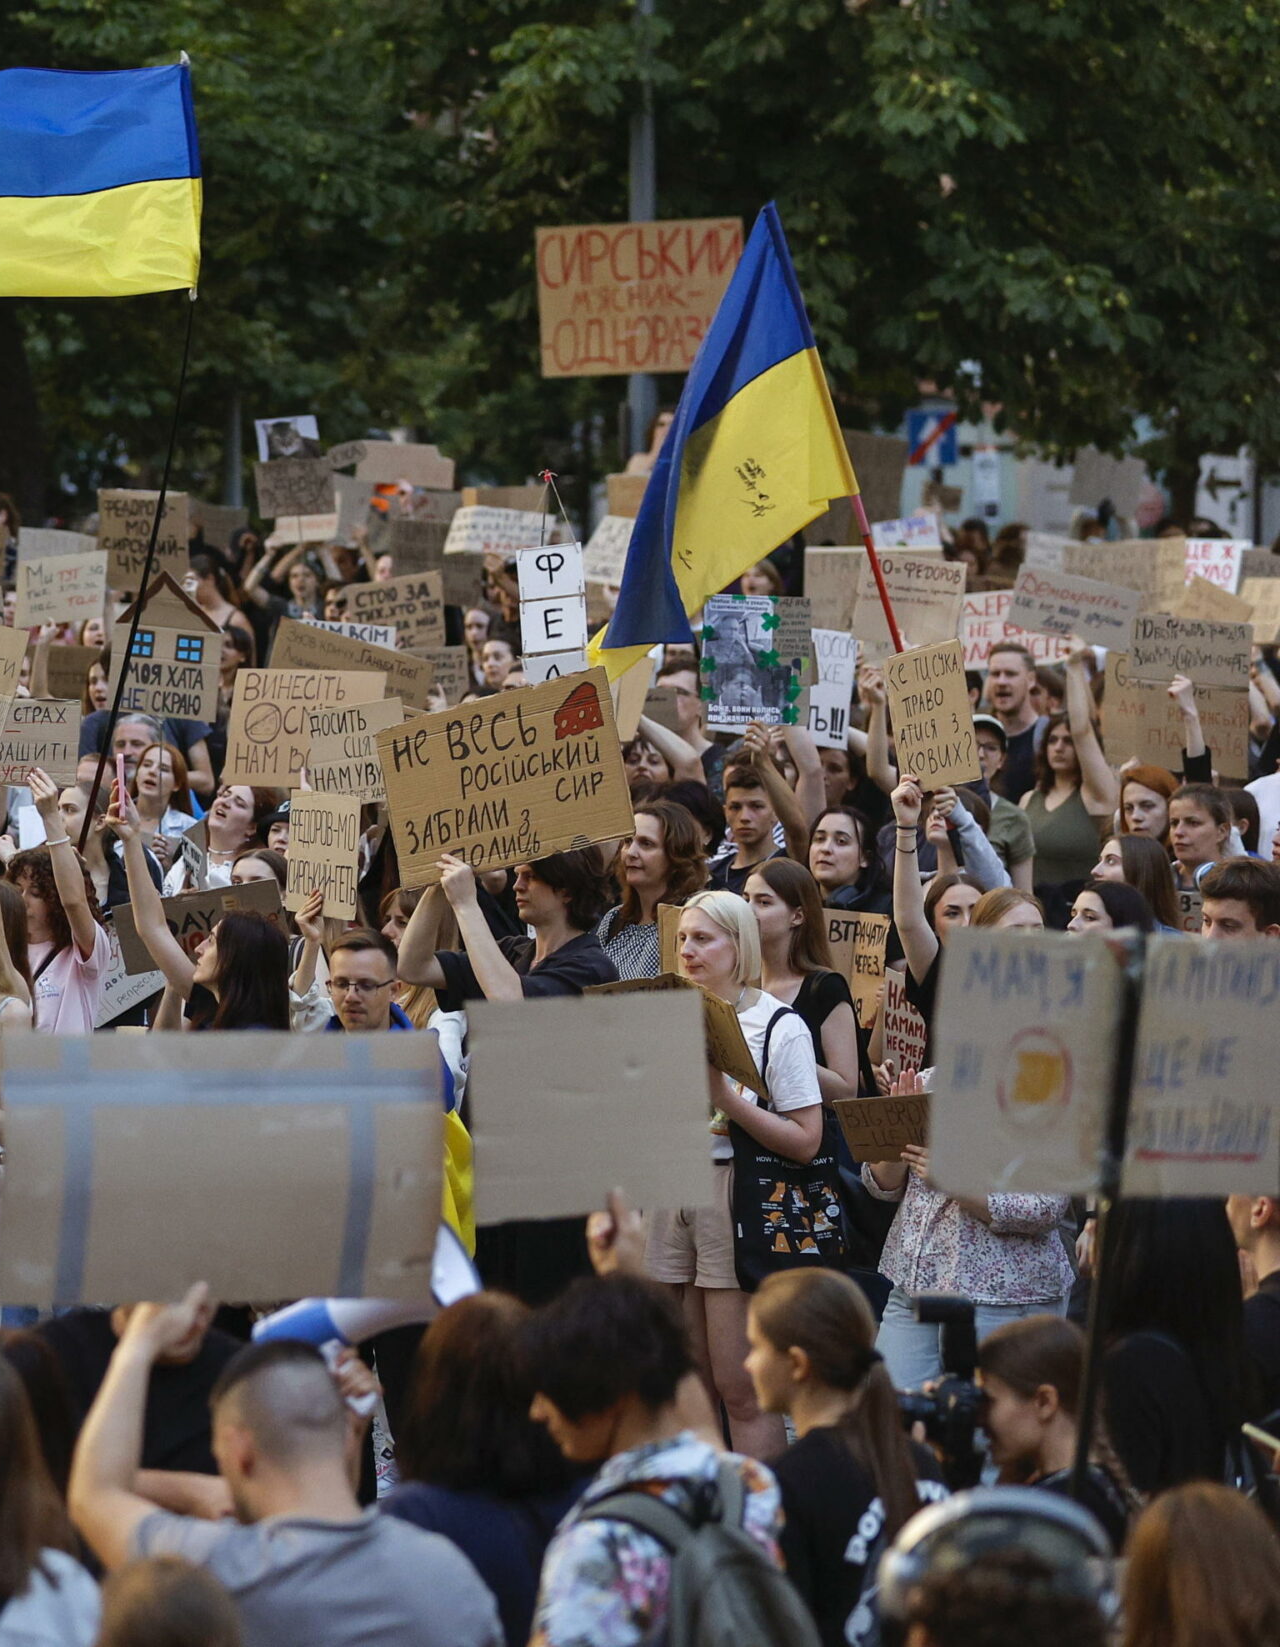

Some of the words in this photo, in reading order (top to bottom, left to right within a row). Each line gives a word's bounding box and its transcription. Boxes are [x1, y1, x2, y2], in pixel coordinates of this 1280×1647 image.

[539, 222, 742, 290] СИРСЬКИЙ
[406, 584, 430, 600] ЗА
[166, 666, 204, 690] ХАТА
[243, 671, 346, 702] ВИНЕСІТЬ
[13, 706, 68, 724] СТРАХ
[120, 686, 146, 711] НЕ
[151, 690, 202, 716] СКРАЮ
[901, 687, 945, 717] ПРАВО
[309, 708, 367, 740] ДОСИТЬ
[234, 743, 278, 775] НАМ
[555, 771, 604, 802] СИР
[405, 799, 510, 855] ЗАБРАЛИ
[829, 919, 888, 948] ВТРАЧАТИ
